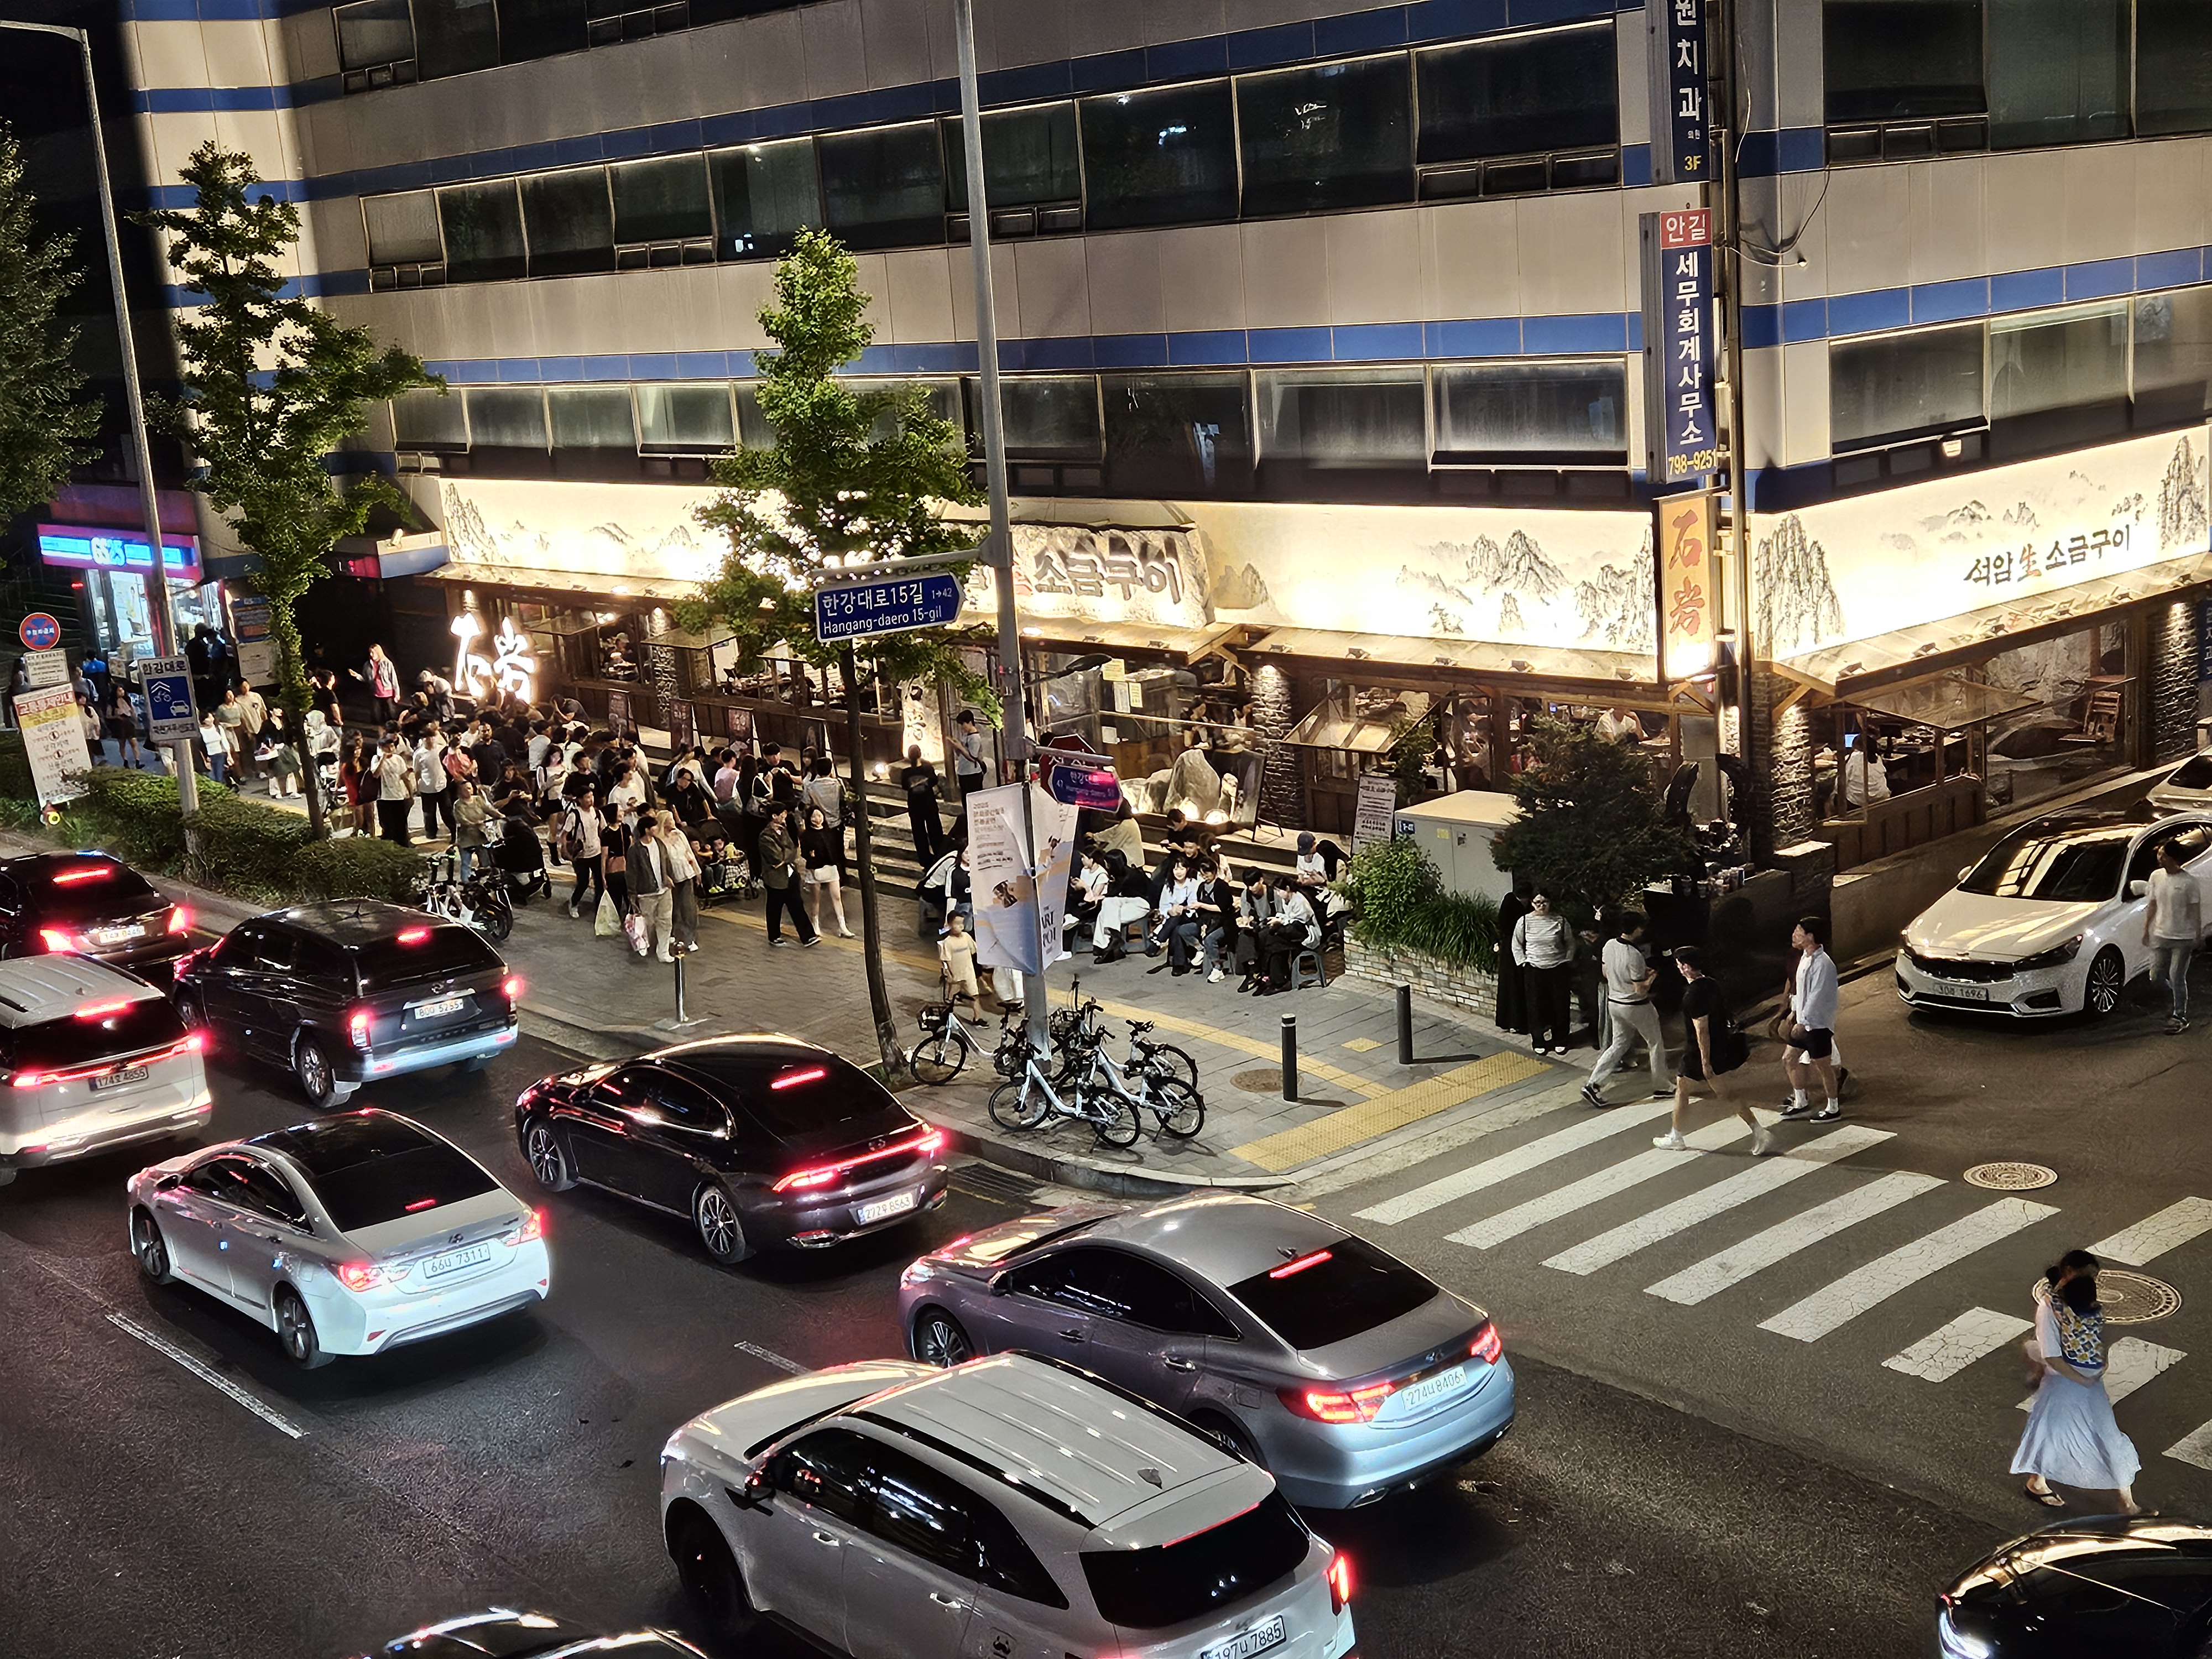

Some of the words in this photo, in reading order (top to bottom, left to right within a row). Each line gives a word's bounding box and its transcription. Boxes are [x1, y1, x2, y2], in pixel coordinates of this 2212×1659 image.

[1684, 155, 1702, 170] 3F
[1666, 214, 1705, 242] 안길
[1676, 251, 1703, 445] 세무회계사무소
[1668, 448, 1717, 476] 798-9251
[91, 537, 126, 566] GS25
[1963, 551, 2013, 586] 석암
[2046, 524, 2129, 570] 소금구이
[1035, 554, 1182, 604] 소금구이
[822, 582, 924, 617] 한강대로15길
[823, 613, 909, 634] Hangang-daero
[912, 605, 942, 622] 15-gil
[143, 660, 187, 675] 한강대로
[1250, 1623, 1281, 1650] 7885
